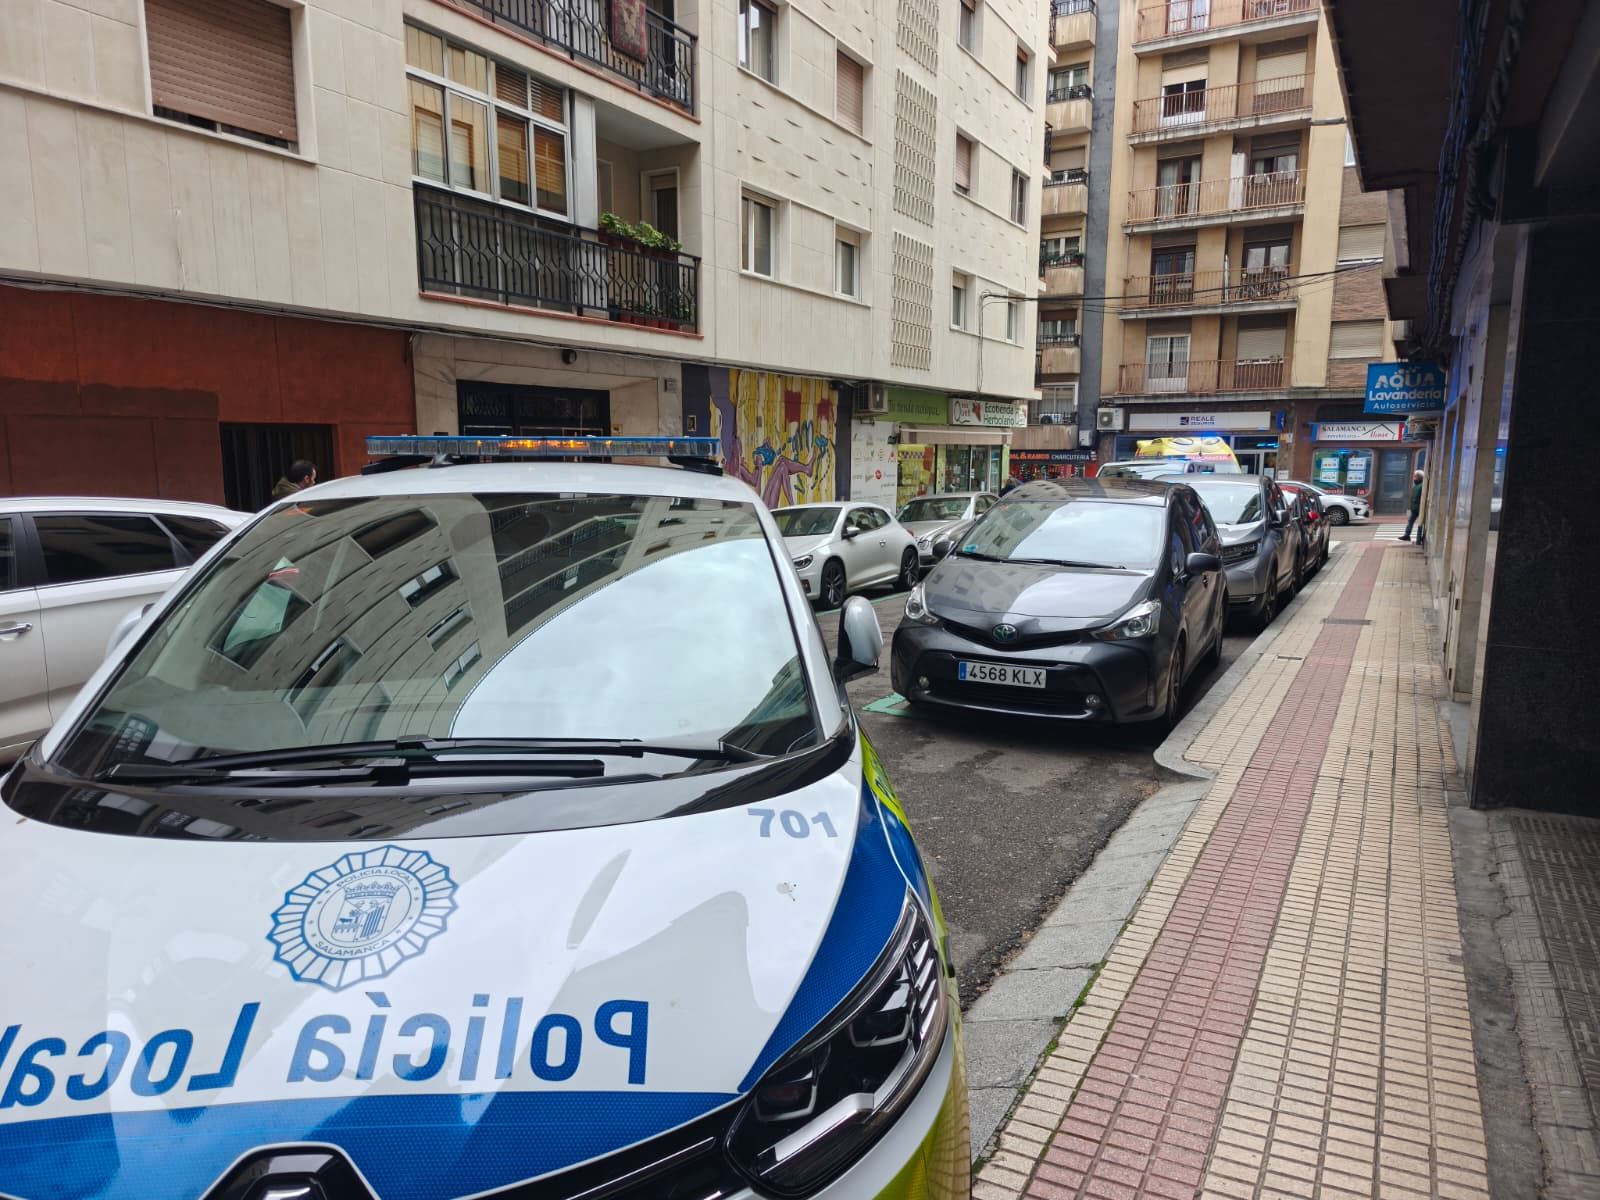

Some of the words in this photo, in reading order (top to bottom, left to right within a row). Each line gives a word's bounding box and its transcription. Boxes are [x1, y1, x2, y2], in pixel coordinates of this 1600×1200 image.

[1375, 373, 1436, 389] AQUA
[1322, 424, 1366, 432] SALAMANCA
[969, 665, 1007, 681] 4568
[1012, 669, 1042, 685] KLX
[747, 808, 838, 839] 701
[315, 940, 391, 957] SALAMANCA
